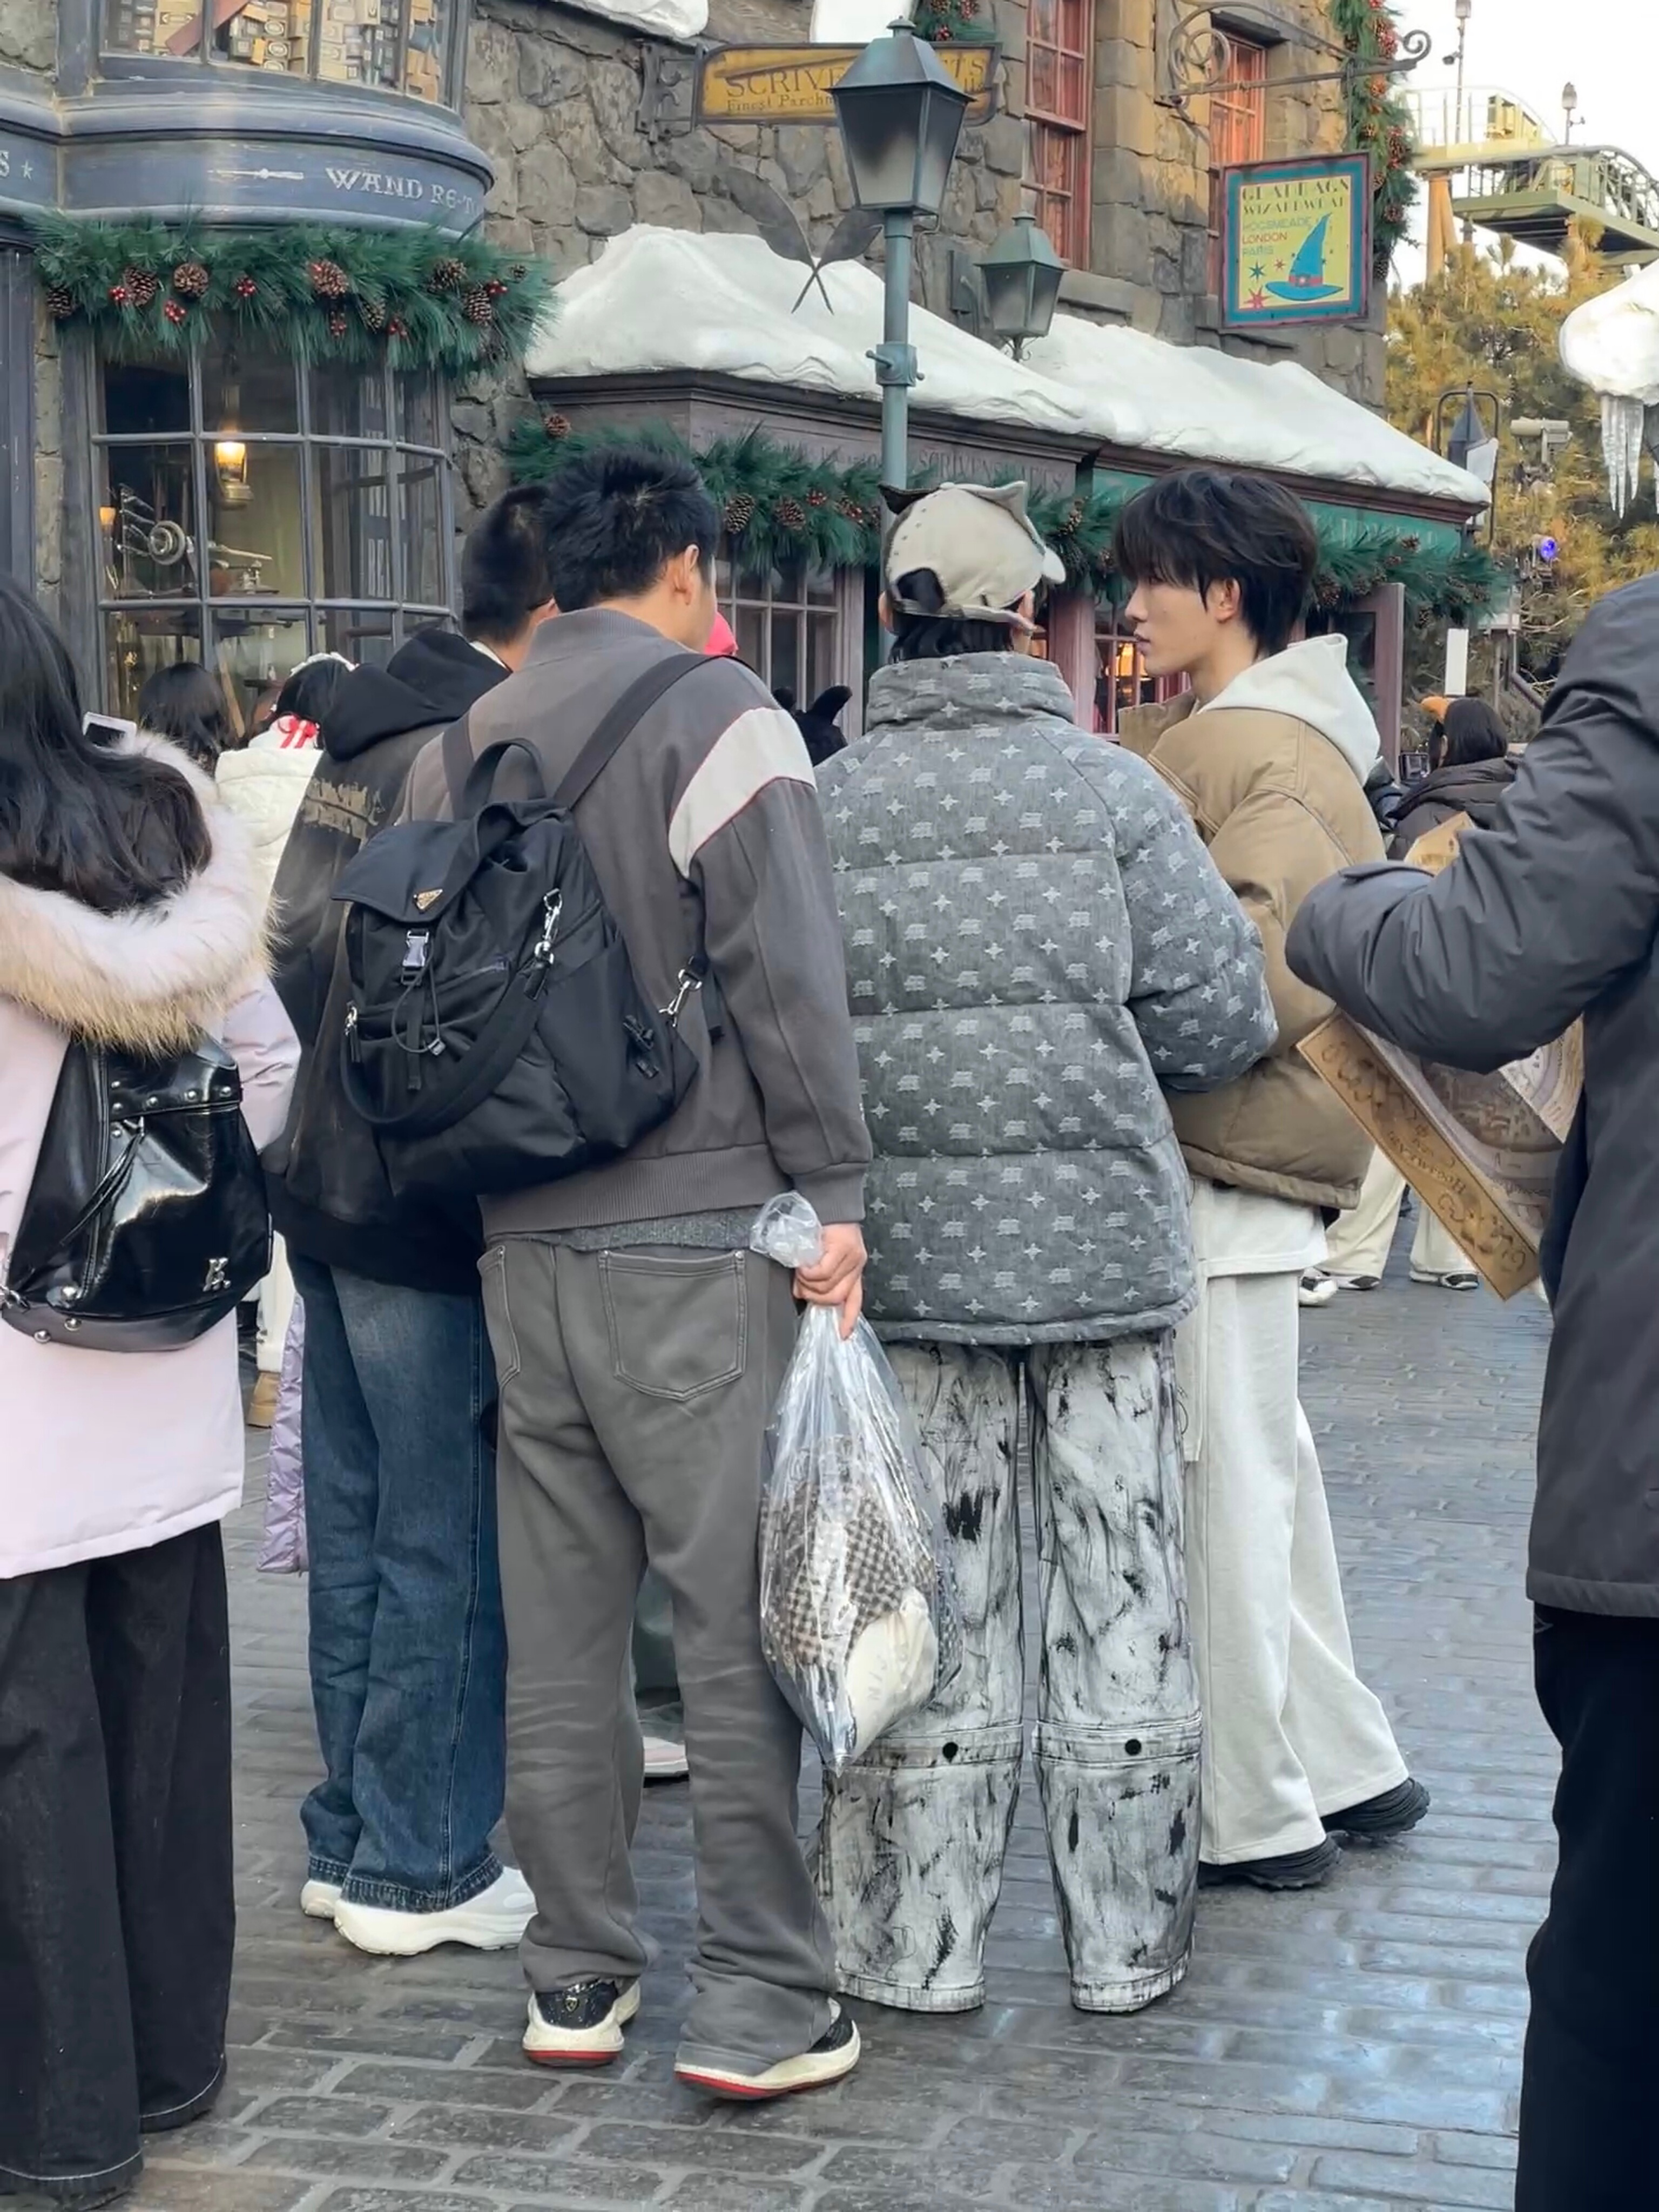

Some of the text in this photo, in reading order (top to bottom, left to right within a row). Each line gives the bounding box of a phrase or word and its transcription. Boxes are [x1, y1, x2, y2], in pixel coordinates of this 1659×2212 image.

[325, 167, 423, 199] WAND
[1243, 232, 1287, 245] LONDON
[1243, 245, 1274, 258] PARIS
